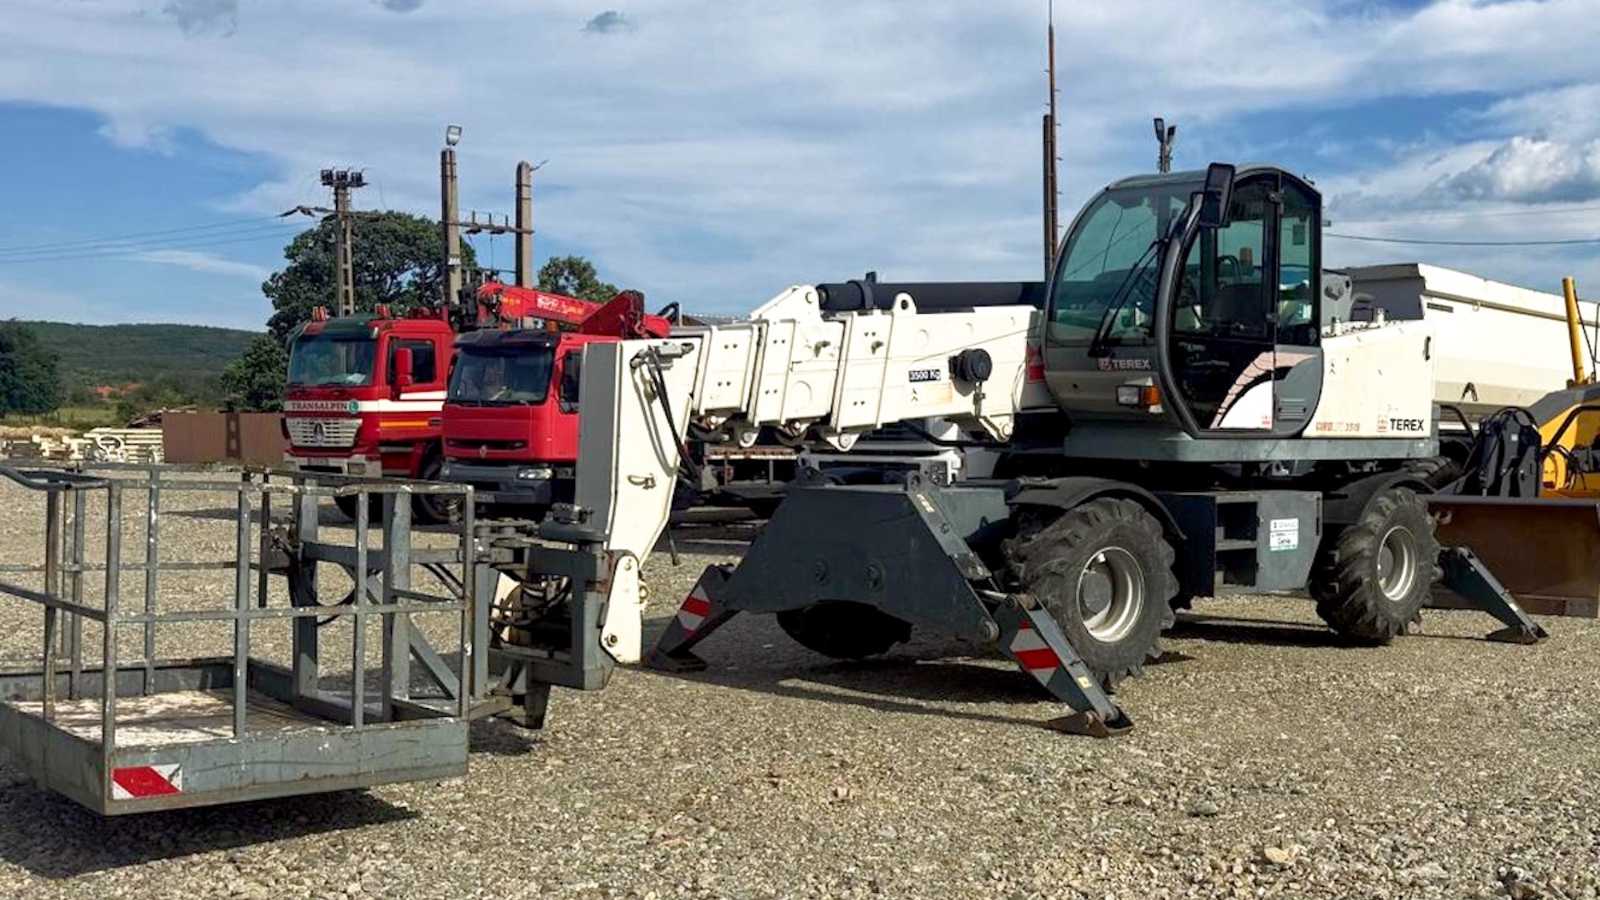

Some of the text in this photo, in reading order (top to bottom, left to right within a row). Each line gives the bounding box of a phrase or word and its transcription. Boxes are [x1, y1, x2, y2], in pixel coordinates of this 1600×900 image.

[1112, 359, 1152, 370] TEREX
[291, 402, 348, 410] TRANSALPIN
[1390, 418, 1424, 431] TEREX
